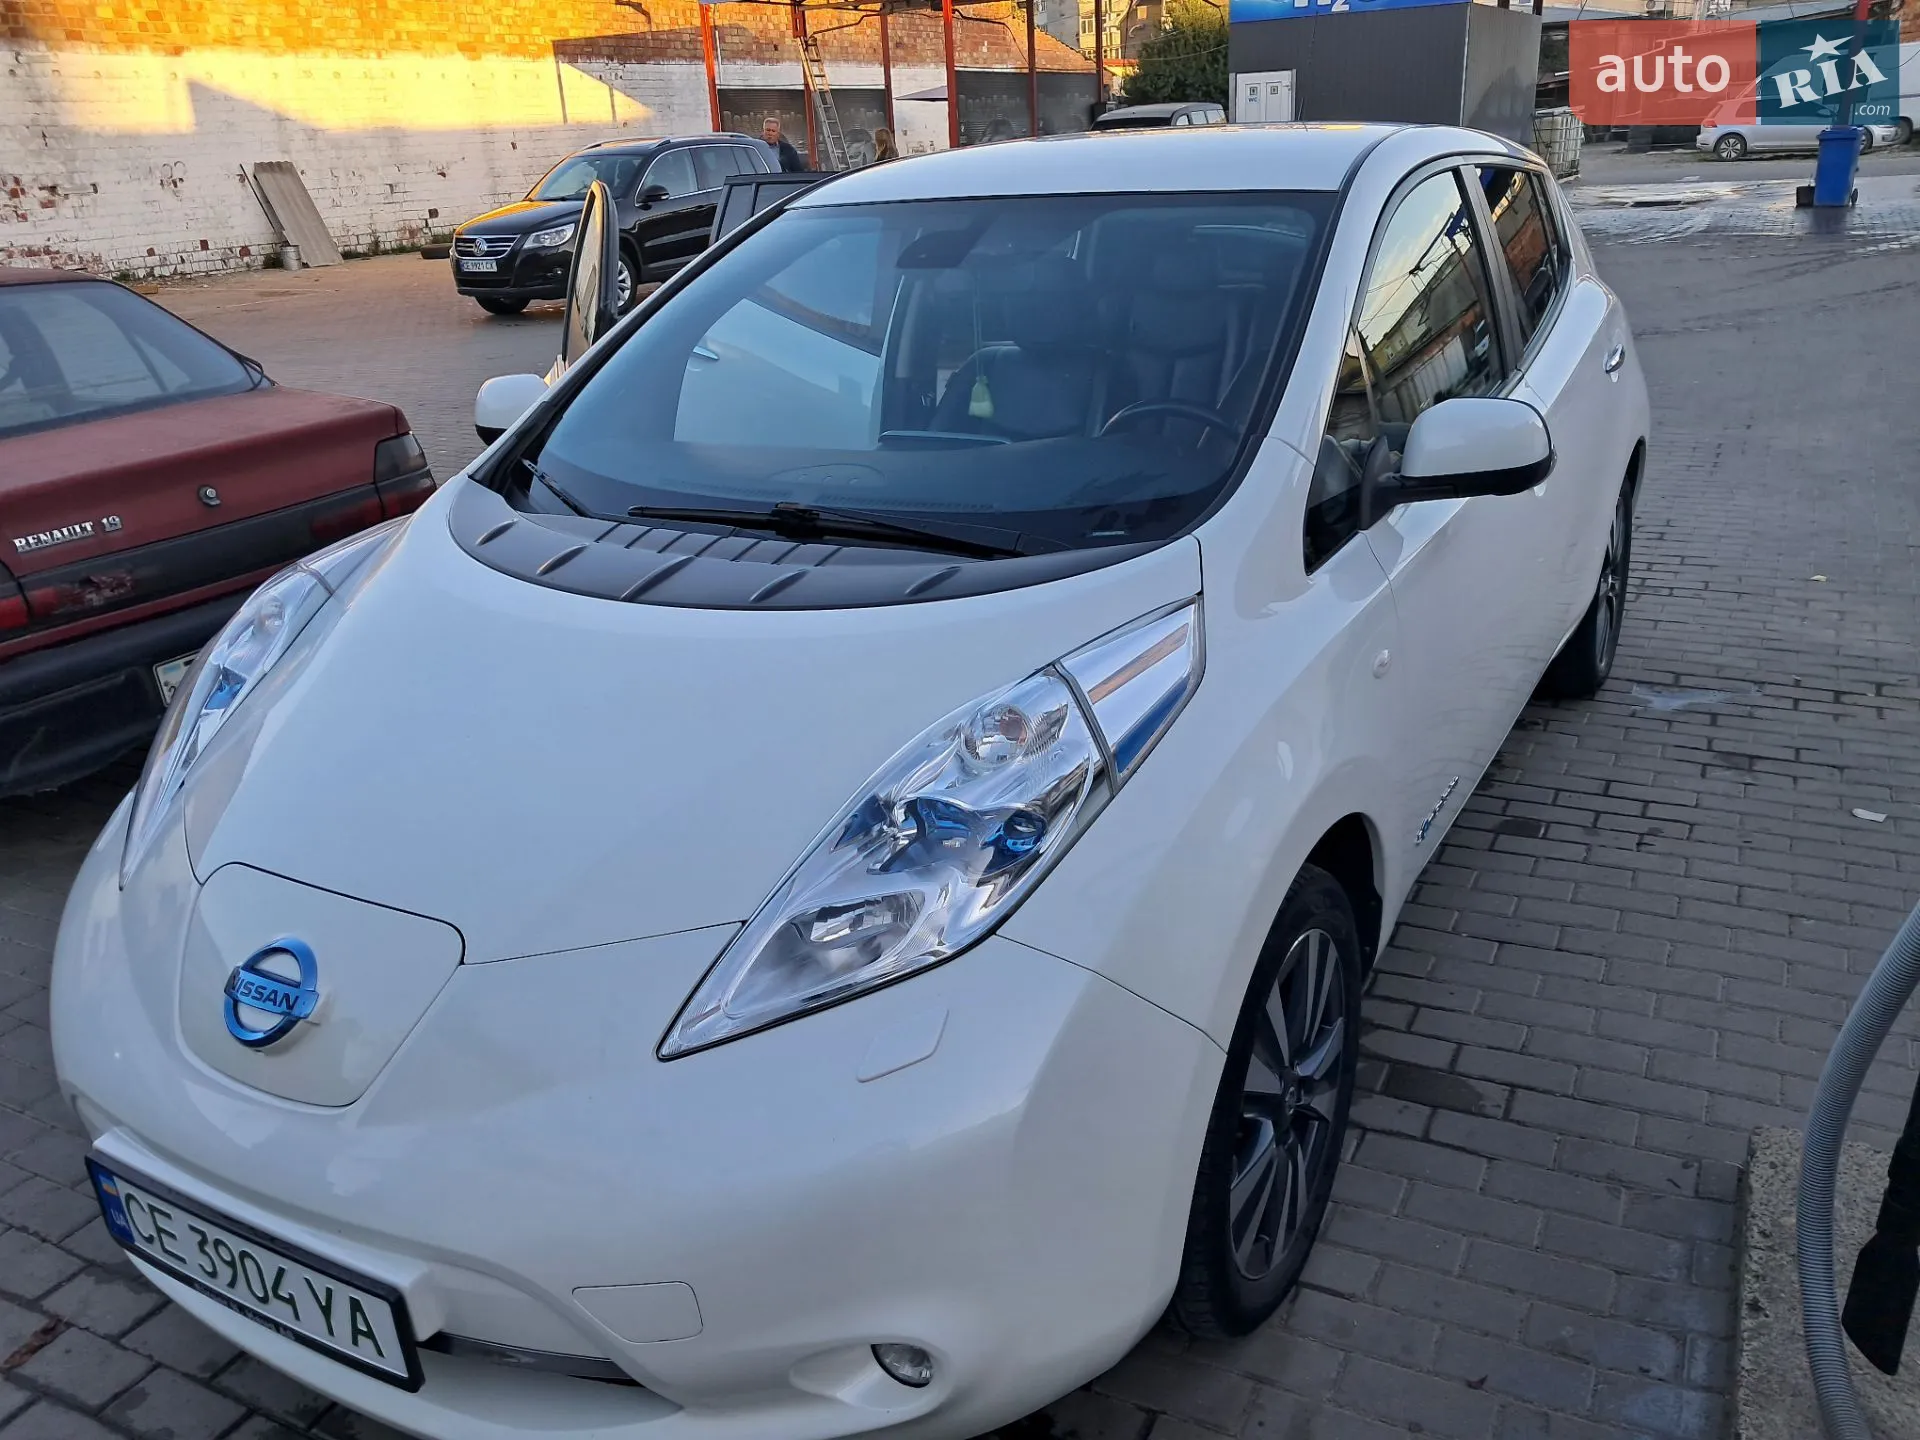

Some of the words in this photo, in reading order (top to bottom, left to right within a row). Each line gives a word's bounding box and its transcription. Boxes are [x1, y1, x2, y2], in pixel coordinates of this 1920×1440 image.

[12, 521, 95, 552] RENAULT
[101, 515, 122, 532] 19
[232, 974, 300, 1012] NISSAN
[124, 1192, 188, 1265] CE
[187, 1223, 301, 1322] 3904
[303, 1275, 386, 1359] YA
